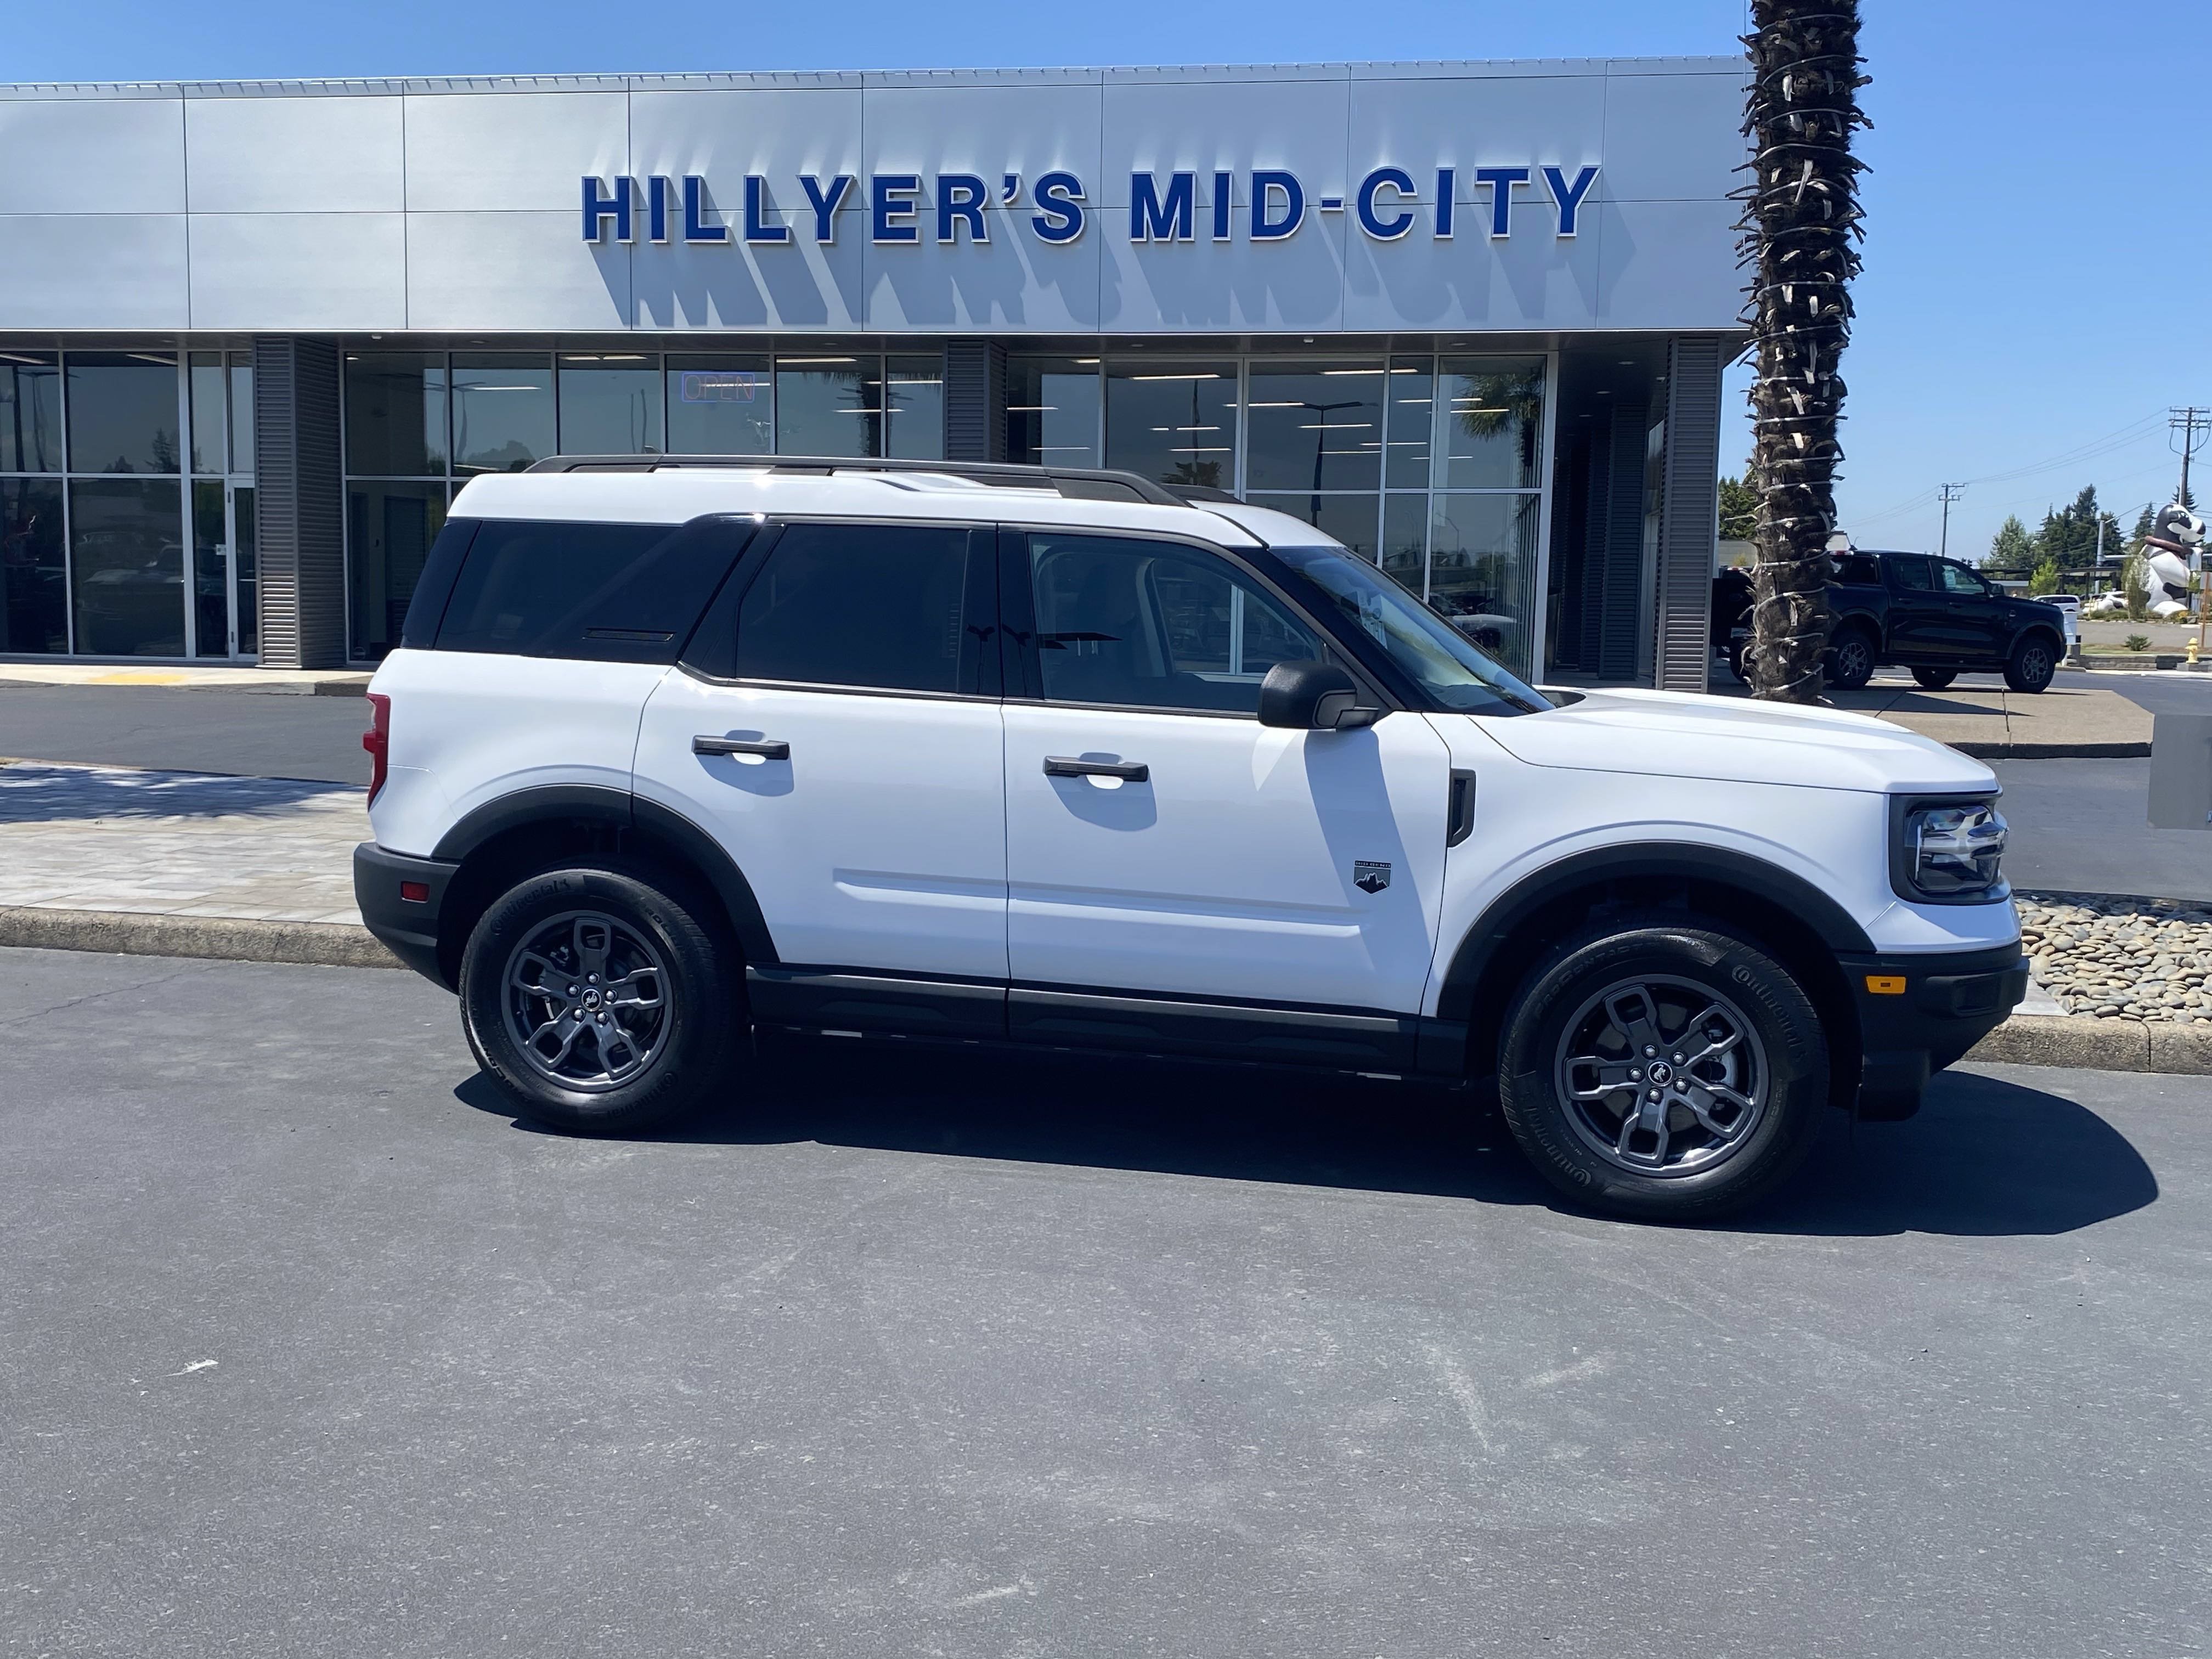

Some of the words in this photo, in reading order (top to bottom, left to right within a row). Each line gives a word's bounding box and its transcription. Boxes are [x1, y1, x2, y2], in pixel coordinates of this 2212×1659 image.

[582, 170, 1086, 244] HILLYER'S
[1130, 165, 1601, 241] MID-CITY
[685, 375, 752, 400] OPEN
[1731, 964, 1804, 1049] Continental
